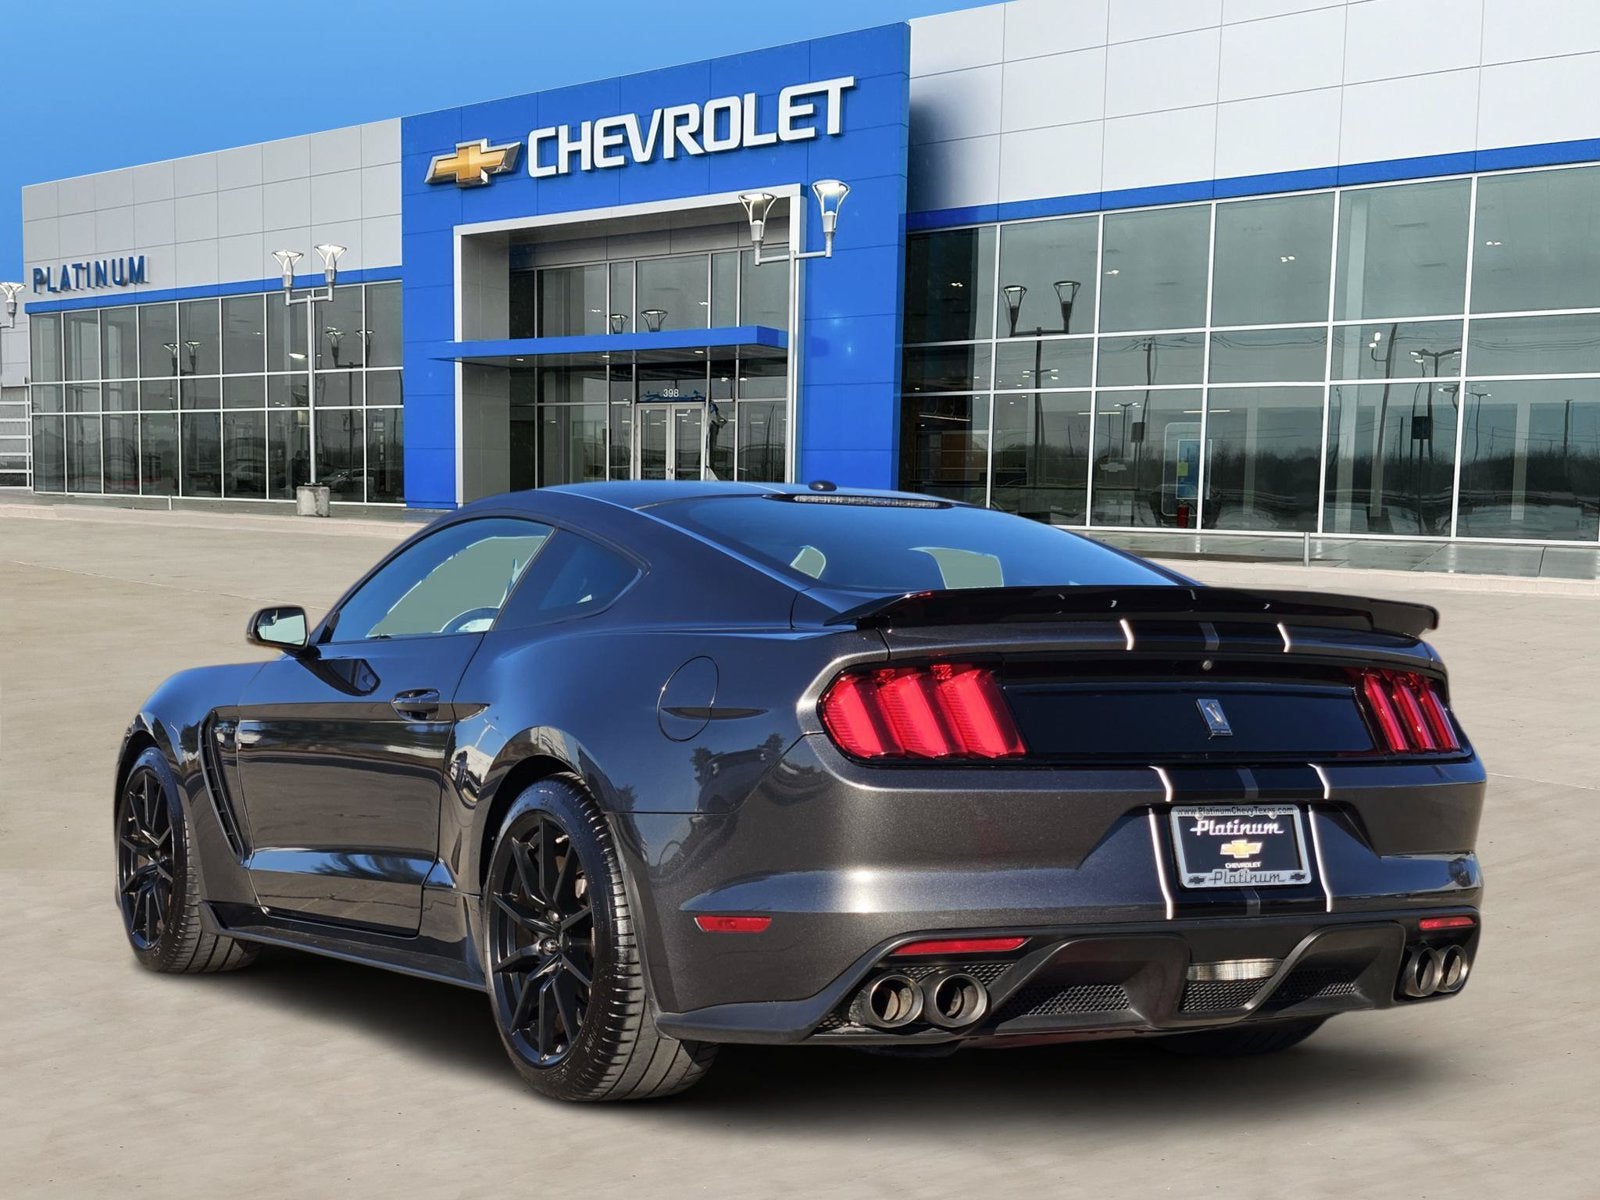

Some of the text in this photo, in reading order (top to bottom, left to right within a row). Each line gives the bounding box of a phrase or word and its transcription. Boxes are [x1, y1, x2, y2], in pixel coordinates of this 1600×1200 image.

[527, 75, 855, 178] CHEVROLET
[33, 255, 147, 294] PLATINUM
[663, 388, 679, 398] 398
[1190, 818, 1285, 836] Platinum
[1225, 861, 1262, 869] CHEVROLET
[1209, 870, 1285, 885] Platinum
